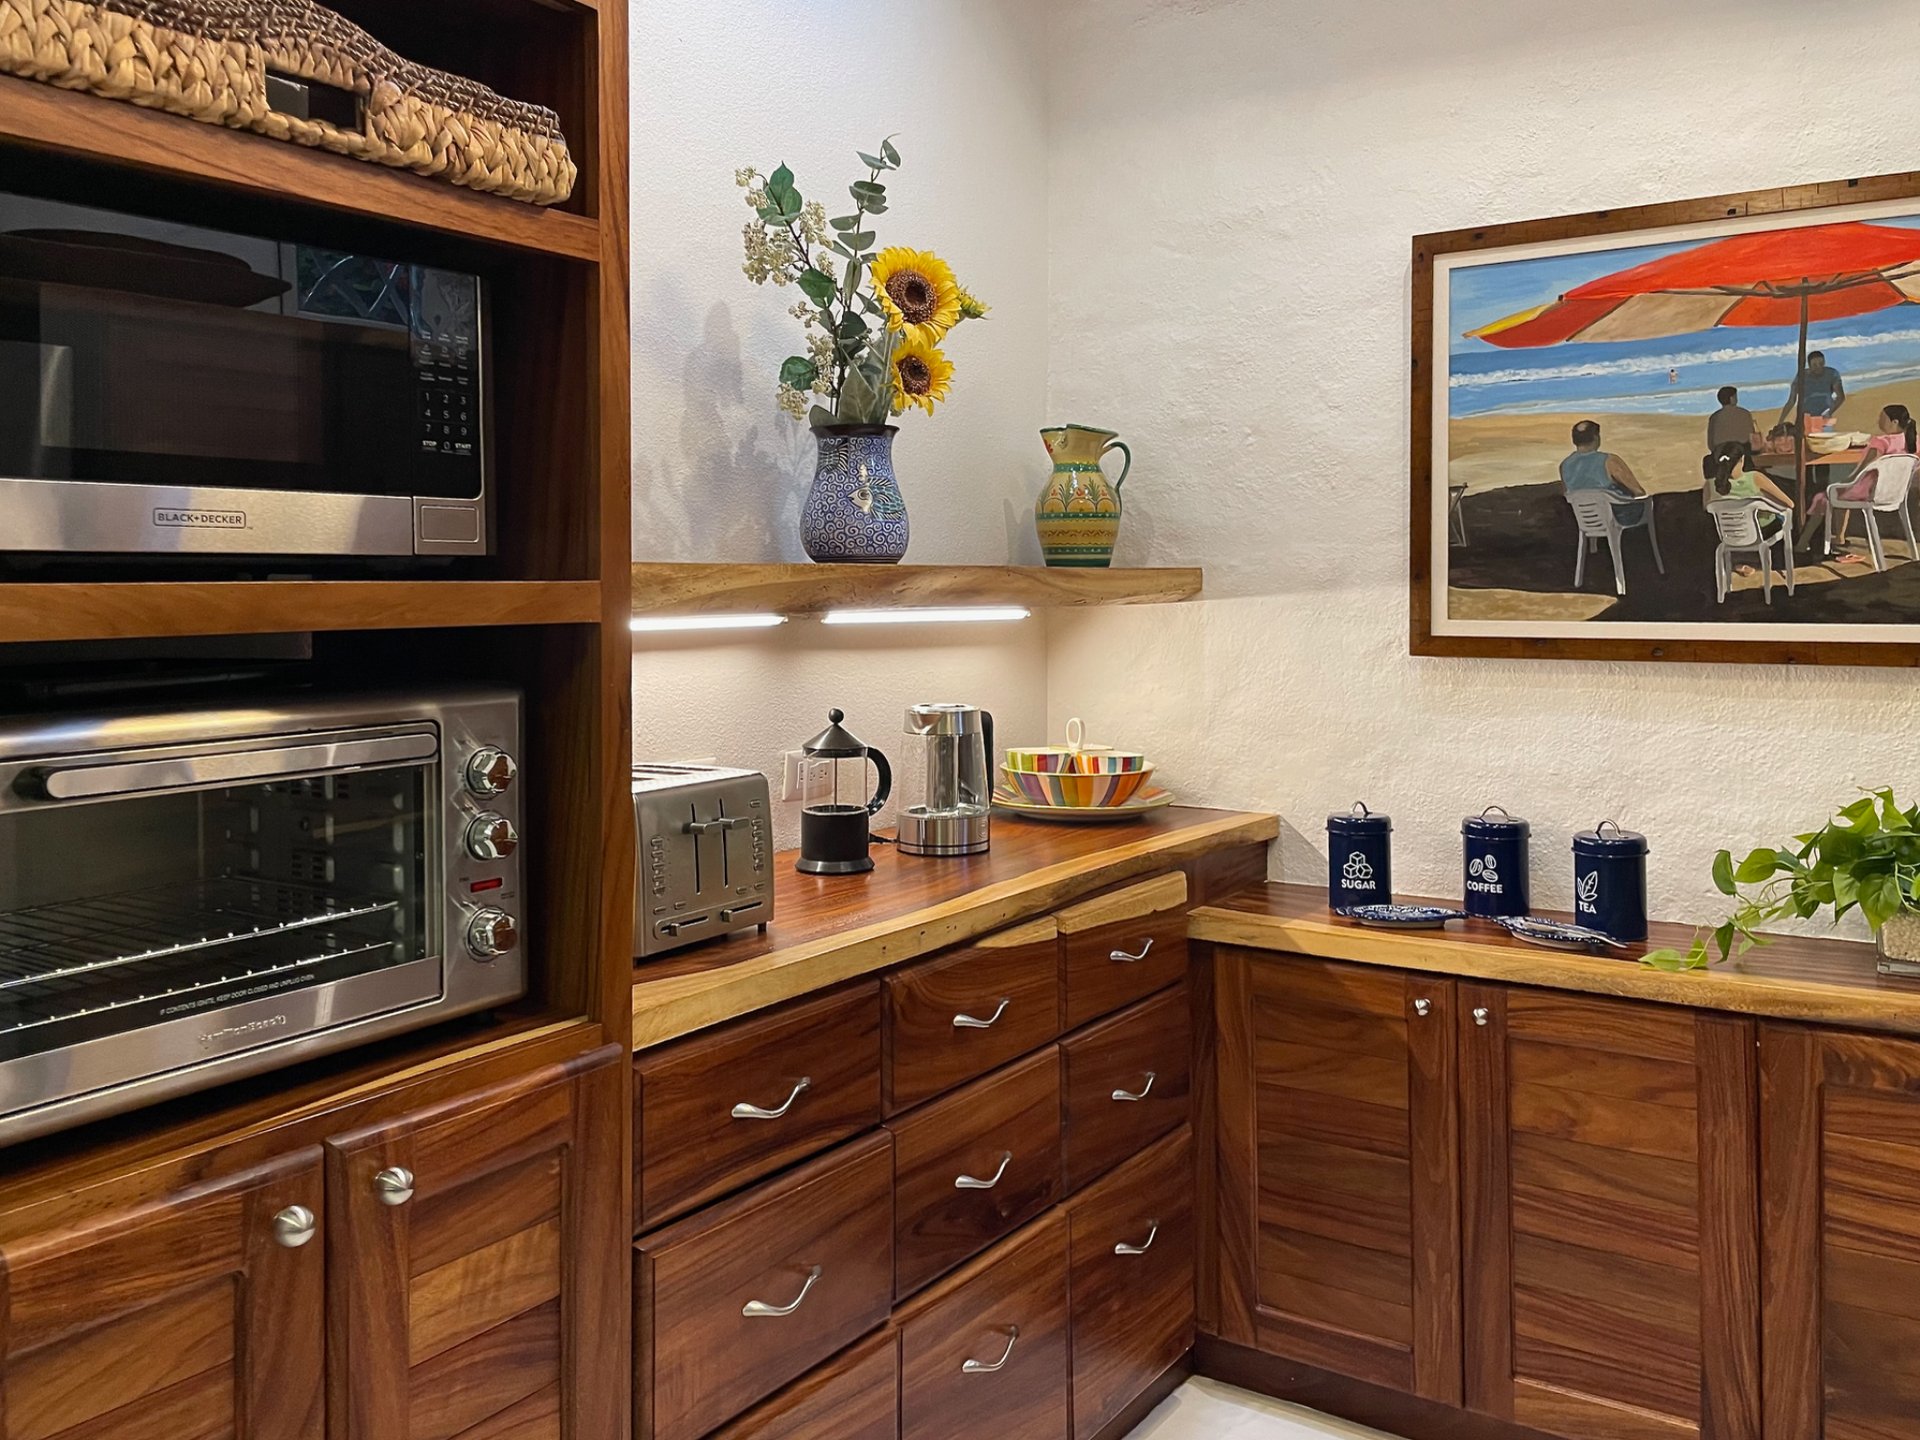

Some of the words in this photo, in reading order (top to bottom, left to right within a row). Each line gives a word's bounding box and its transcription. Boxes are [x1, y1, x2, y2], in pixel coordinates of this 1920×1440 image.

[443, 394, 449, 404] 2
[460, 396, 467, 405] 3
[424, 409, 431, 417] 4
[443, 410, 450, 419] 5
[460, 411, 467, 421] 6
[425, 423, 431, 432] 7
[443, 425, 450, 435] 8
[460, 427, 467, 436] 9
[157, 512, 242, 524] BLACK+DECKER
[1341, 878, 1376, 890] SUGAR
[1466, 880, 1503, 894] COFFEE
[1578, 900, 1597, 914] TEA
[231, 990, 247, 999] DOOR
